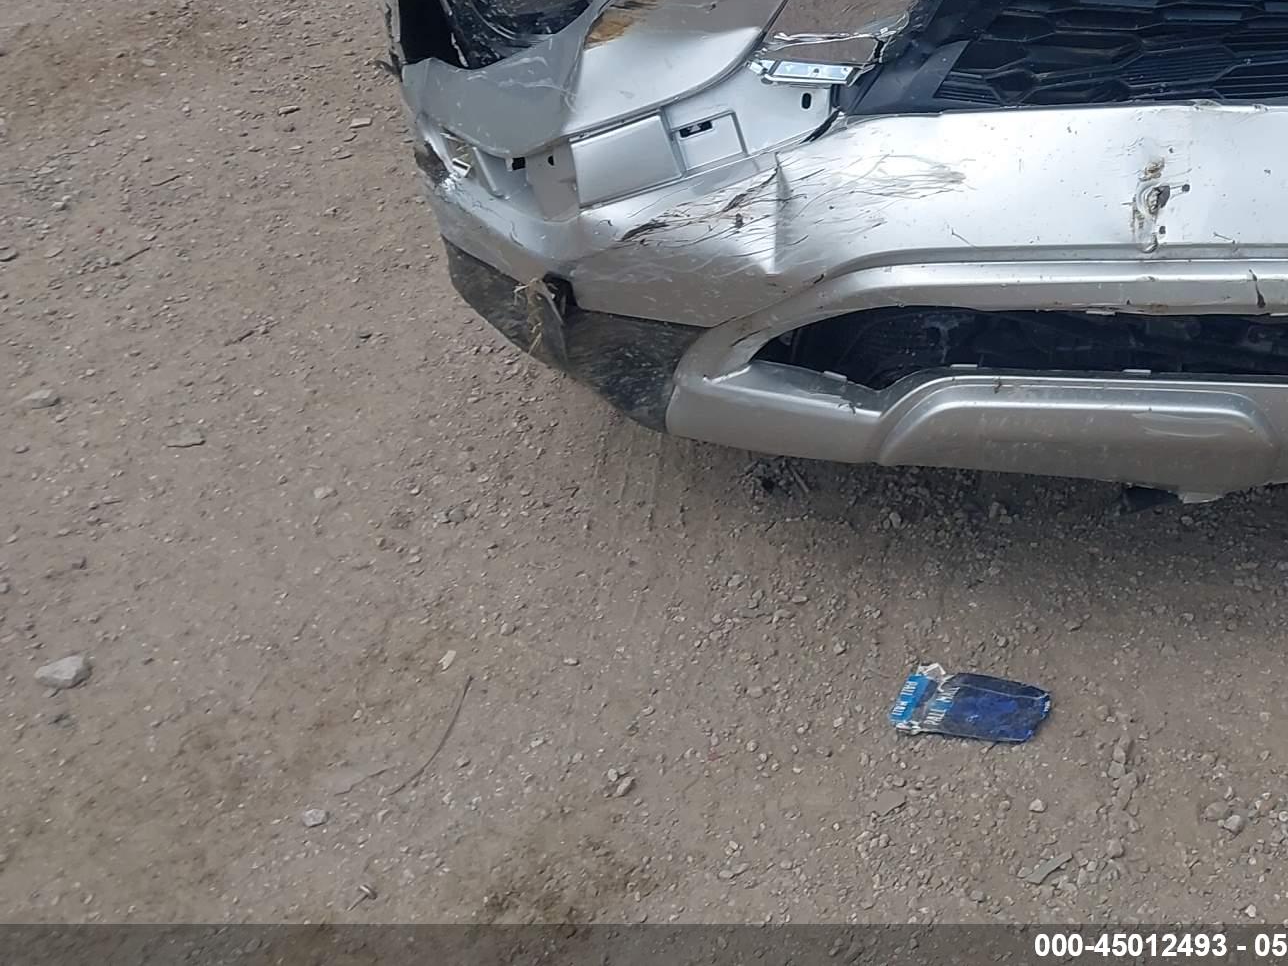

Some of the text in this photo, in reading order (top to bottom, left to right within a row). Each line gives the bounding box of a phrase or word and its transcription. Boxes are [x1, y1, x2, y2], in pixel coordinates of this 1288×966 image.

[891, 681, 919, 717] PALL MALL
[923, 708, 948, 725] PALL
